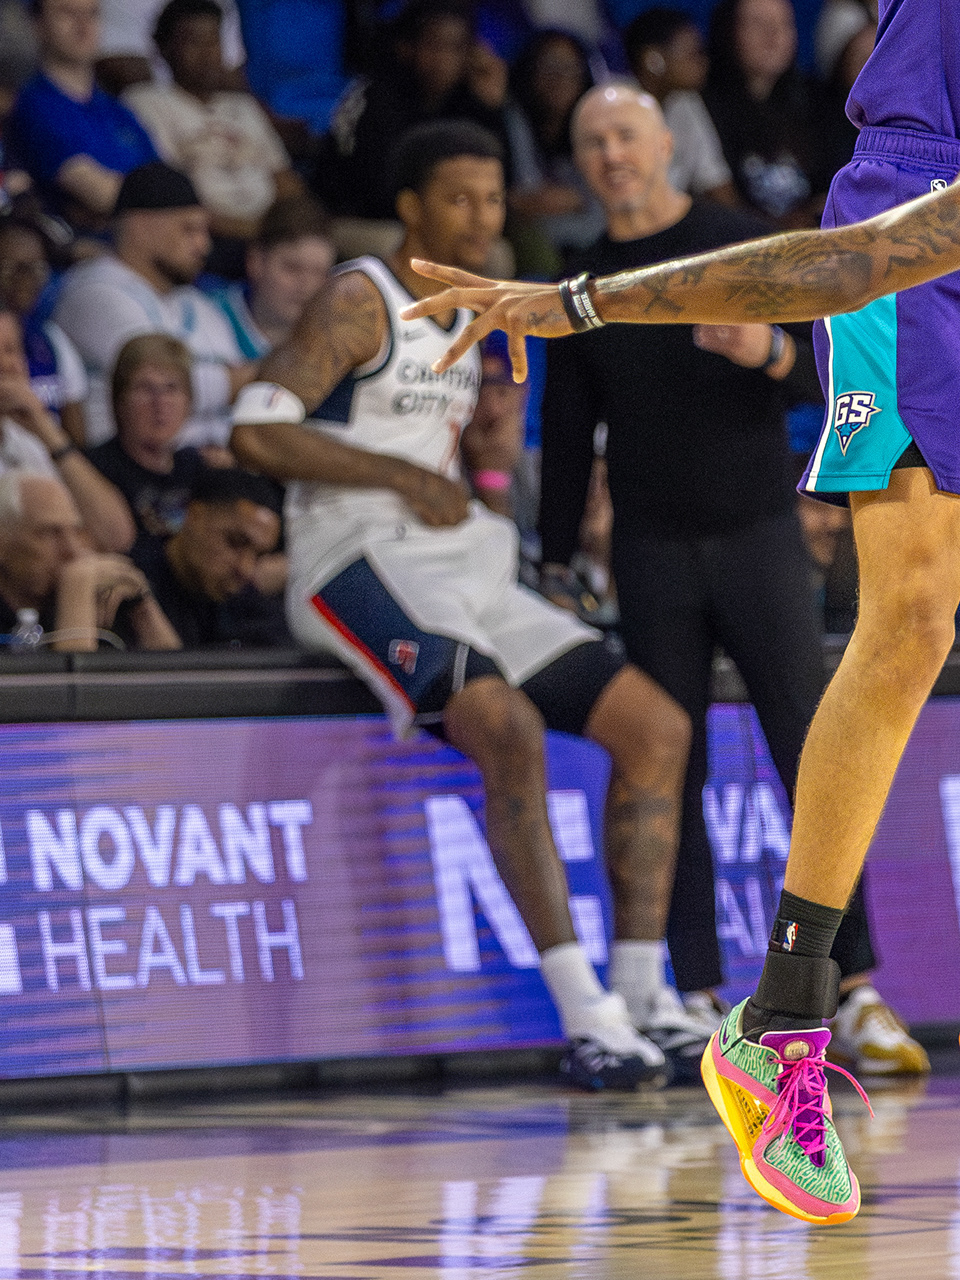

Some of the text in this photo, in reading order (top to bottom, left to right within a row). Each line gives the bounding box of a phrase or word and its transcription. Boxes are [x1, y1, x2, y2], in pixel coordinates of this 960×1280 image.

[835, 394, 872, 427] GS
[25, 799, 313, 892] NOVANT
[37, 898, 305, 993] HEALTH
